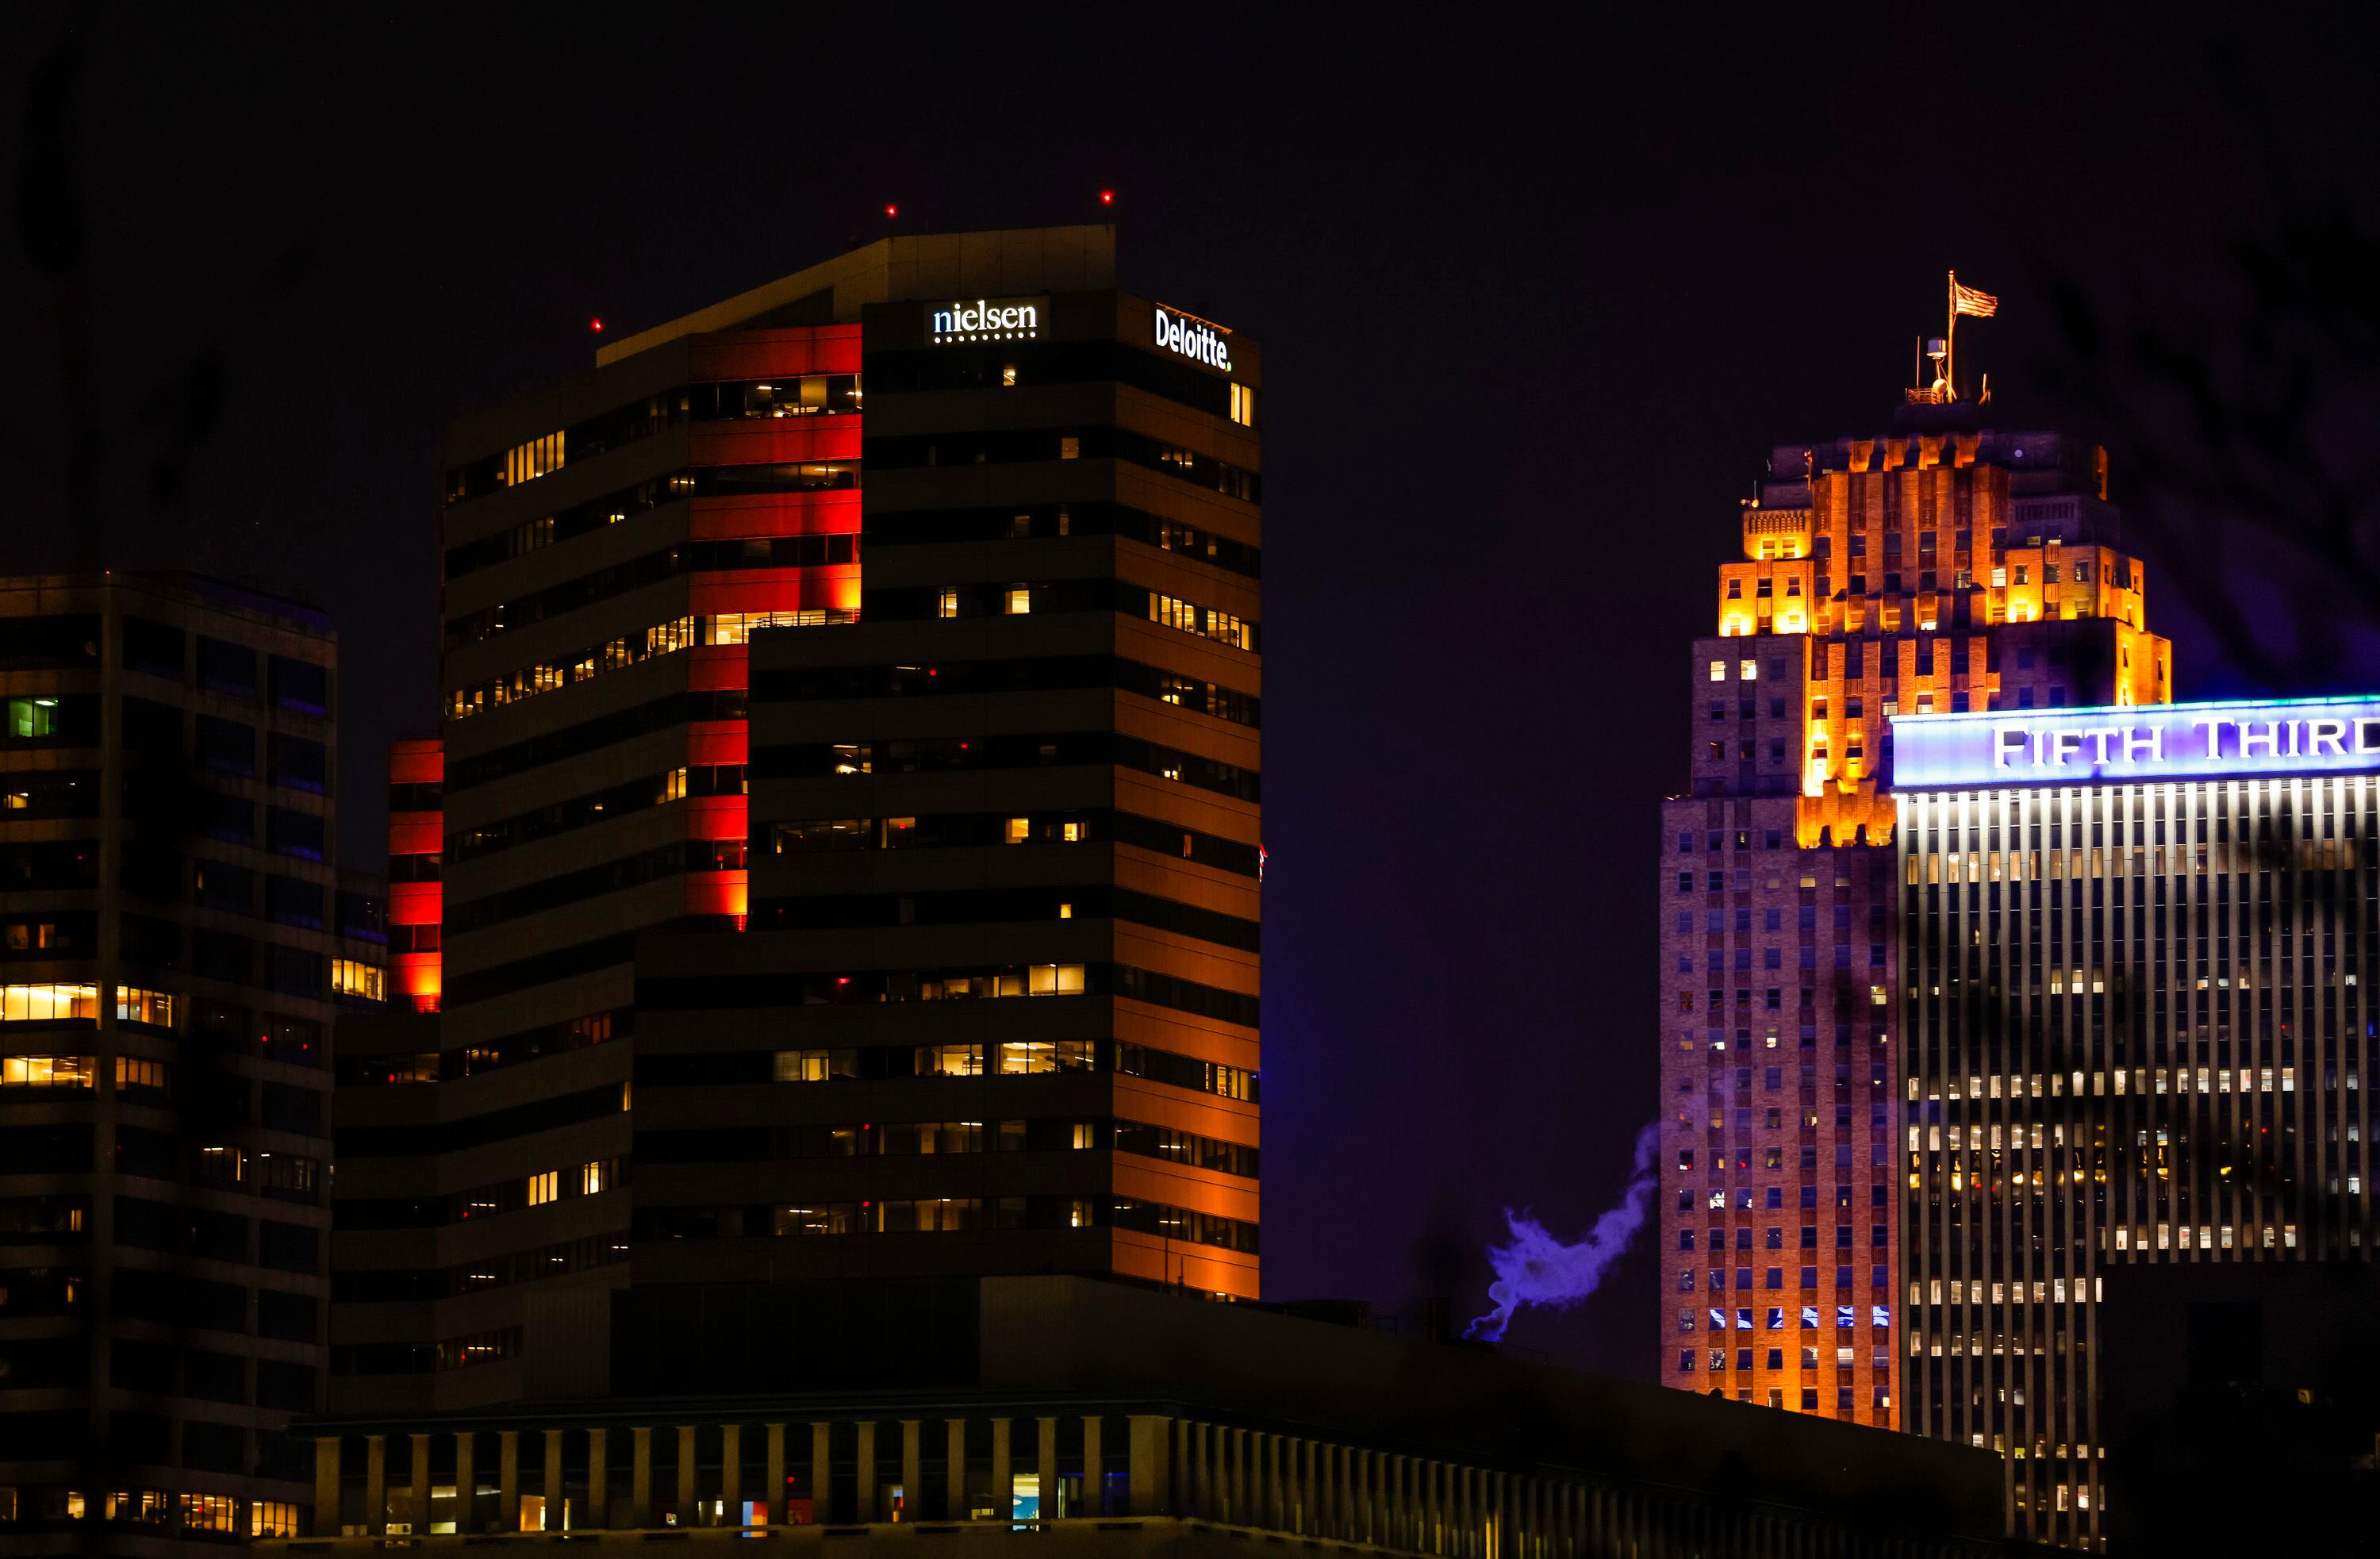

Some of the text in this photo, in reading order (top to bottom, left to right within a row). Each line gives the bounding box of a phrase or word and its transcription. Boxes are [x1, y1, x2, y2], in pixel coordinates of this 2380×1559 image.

[933, 300, 1037, 333] nielsen
[1992, 716, 2380, 769] FIFTH THIRD
